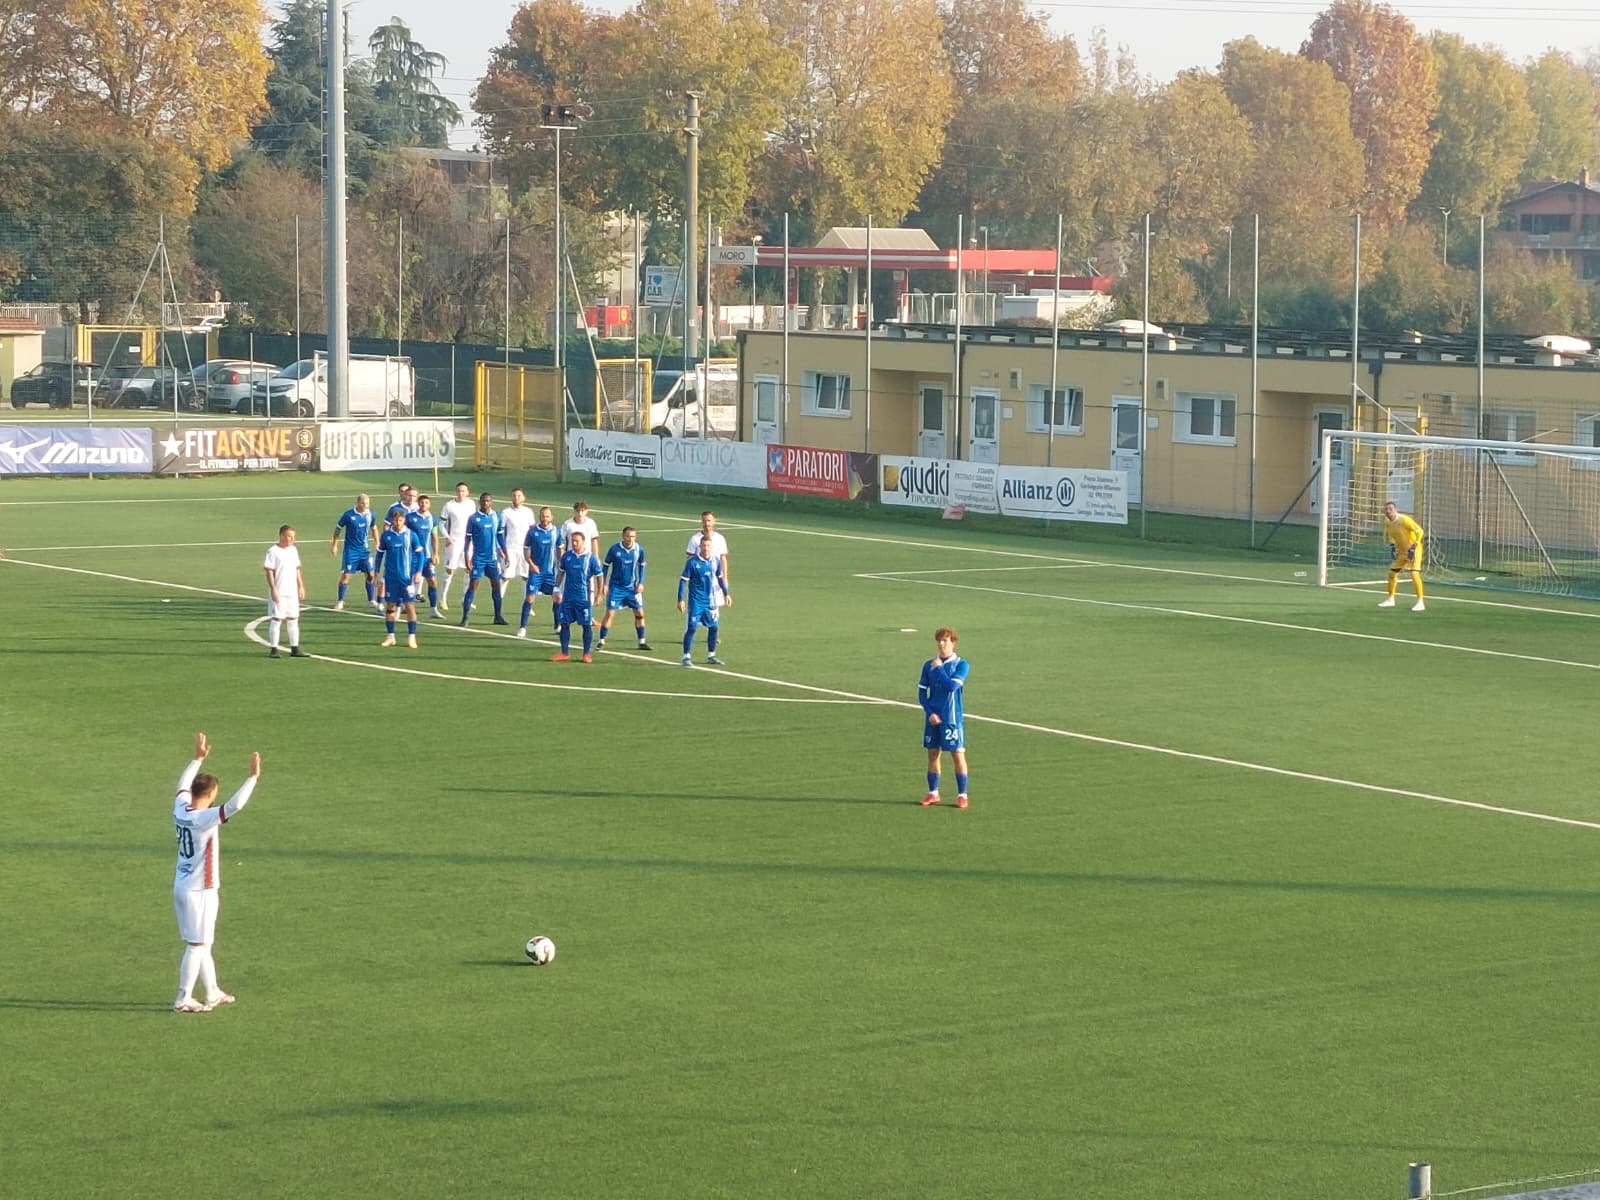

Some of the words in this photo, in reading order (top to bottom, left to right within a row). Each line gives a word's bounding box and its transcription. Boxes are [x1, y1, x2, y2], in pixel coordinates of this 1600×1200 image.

[719, 251, 746, 261] MORO
[323, 430, 393, 460] WIENER
[787, 448, 844, 482] PARATORI
[900, 459, 950, 499] giudici
[1002, 478, 1053, 501] Allianz
[945, 728, 959, 740] 24
